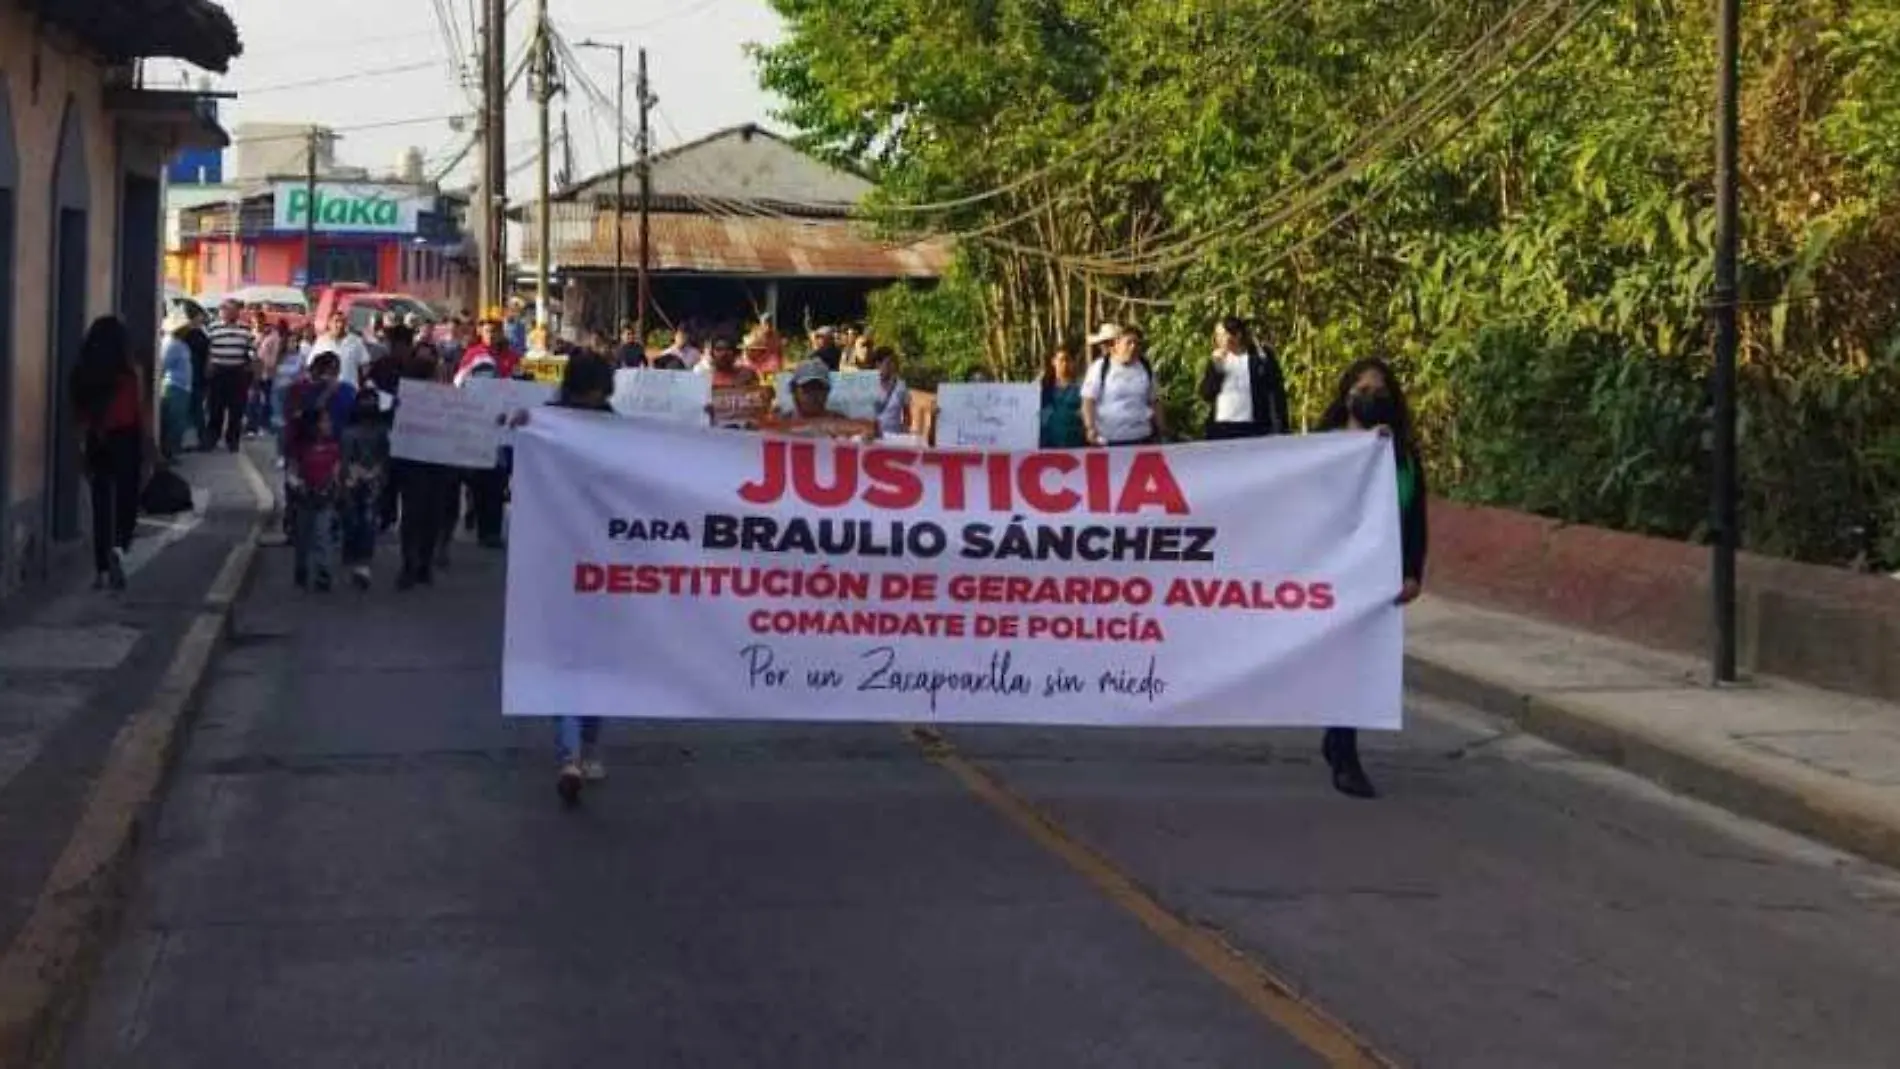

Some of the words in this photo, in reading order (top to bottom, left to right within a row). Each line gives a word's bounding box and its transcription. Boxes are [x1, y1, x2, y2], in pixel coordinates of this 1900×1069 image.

[737, 439, 1190, 515] JUSTICIA
[608, 518, 691, 541] PARA
[702, 514, 947, 557] BRAULIO
[960, 514, 1217, 561] SÁNCHEZ
[574, 563, 869, 600] DESTITUCIÓN
[880, 574, 938, 601] DE
[948, 576, 1154, 605] GERARDO
[1165, 578, 1335, 610] AVALOS
[750, 609, 965, 637] COMANDATE
[973, 614, 1019, 639] DE
[1027, 613, 1164, 641] POLICÍA
[739, 644, 790, 690] Por
[806, 669, 843, 690] un
[1042, 667, 1086, 697] sin
[1099, 655, 1168, 702] miedo
